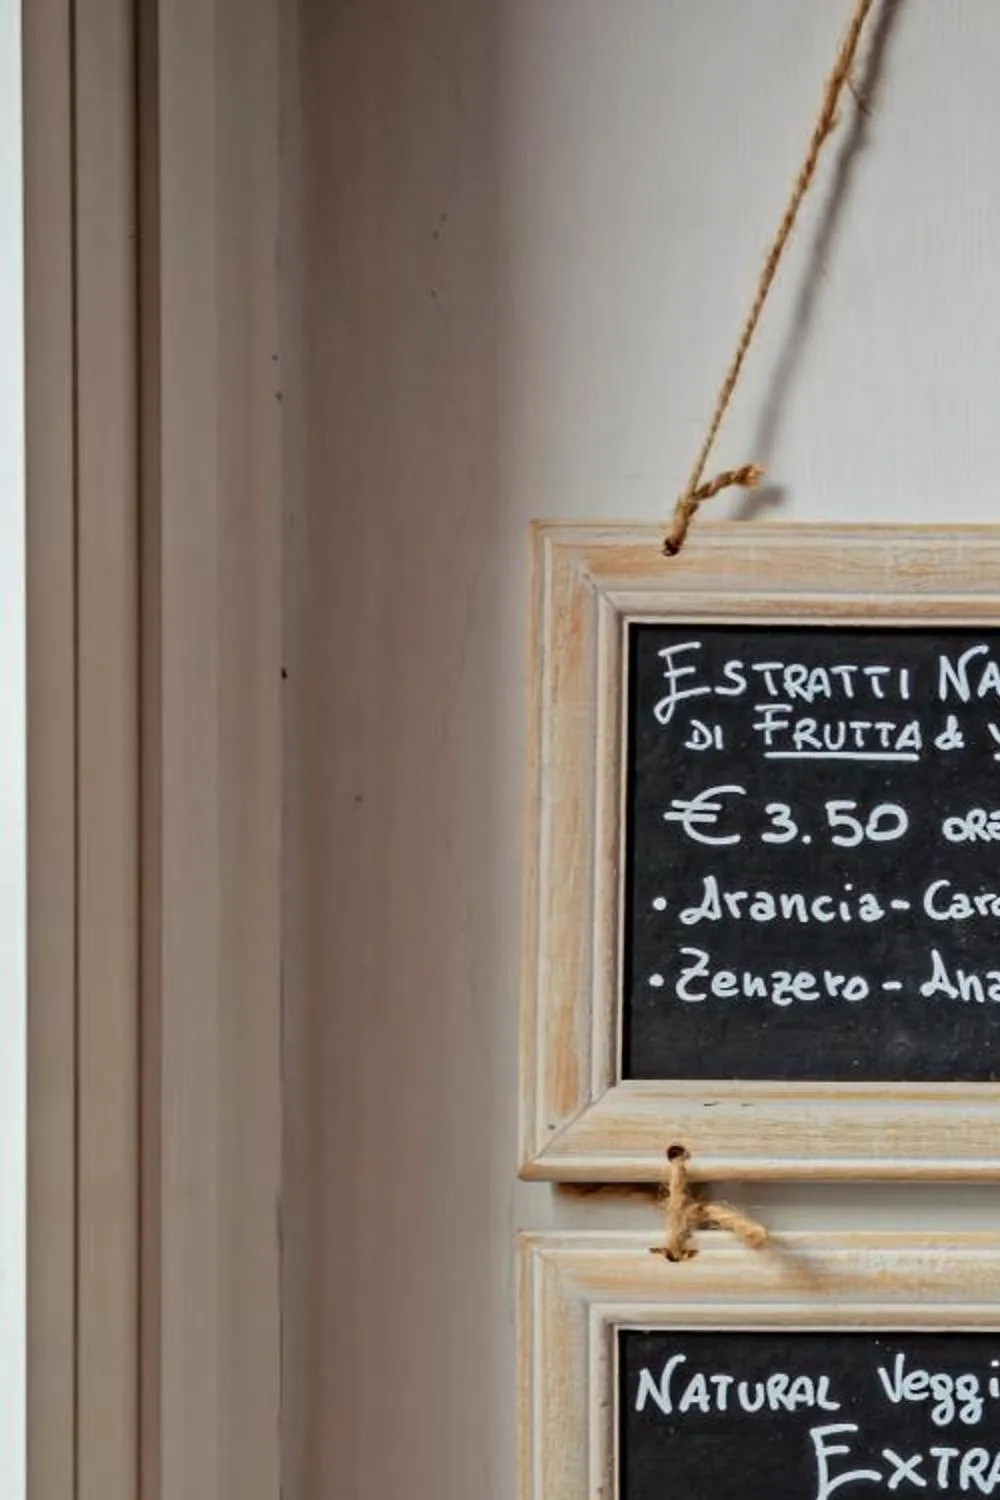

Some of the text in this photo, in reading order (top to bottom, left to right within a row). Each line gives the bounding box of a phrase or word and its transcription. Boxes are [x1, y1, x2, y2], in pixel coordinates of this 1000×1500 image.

[653, 641, 913, 726] ESTRATTI
[684, 719, 724, 751] DI
[752, 703, 923, 751] FRUTTA
[934, 714, 965, 751] &
[761, 799, 909, 848] 3.50
[675, 947, 870, 1007] Zenzero
[635, 1354, 841, 1415] NATURAL
